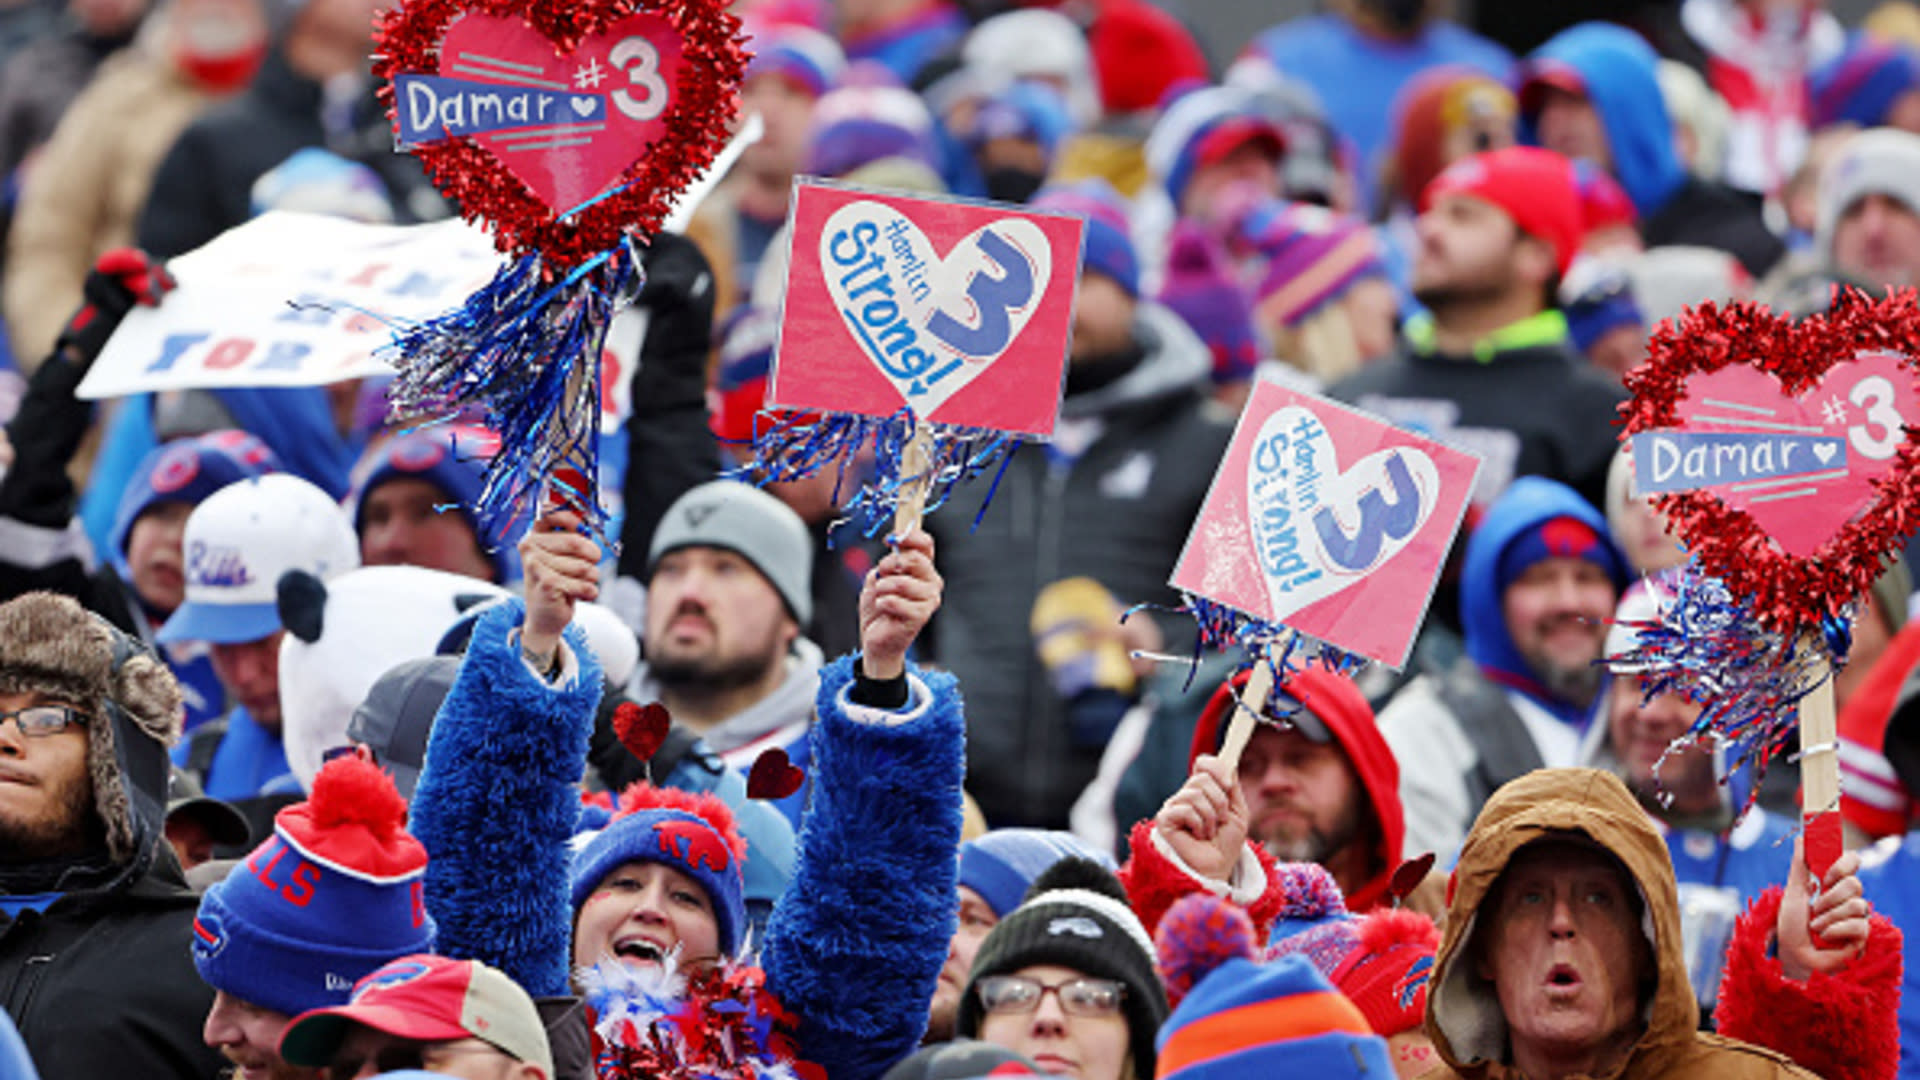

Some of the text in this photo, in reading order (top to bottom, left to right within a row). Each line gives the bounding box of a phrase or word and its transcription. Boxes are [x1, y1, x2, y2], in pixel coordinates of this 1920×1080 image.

[407, 81, 553, 131] Damar
[830, 221, 963, 396] Strong!
[885, 219, 931, 304] Hamlin
[926, 229, 1034, 356] 3
[1254, 433, 1322, 592] Strong!
[1292, 417, 1324, 512] Hamlin
[1312, 453, 1420, 570] 3
[1653, 437, 1799, 483] Damar
